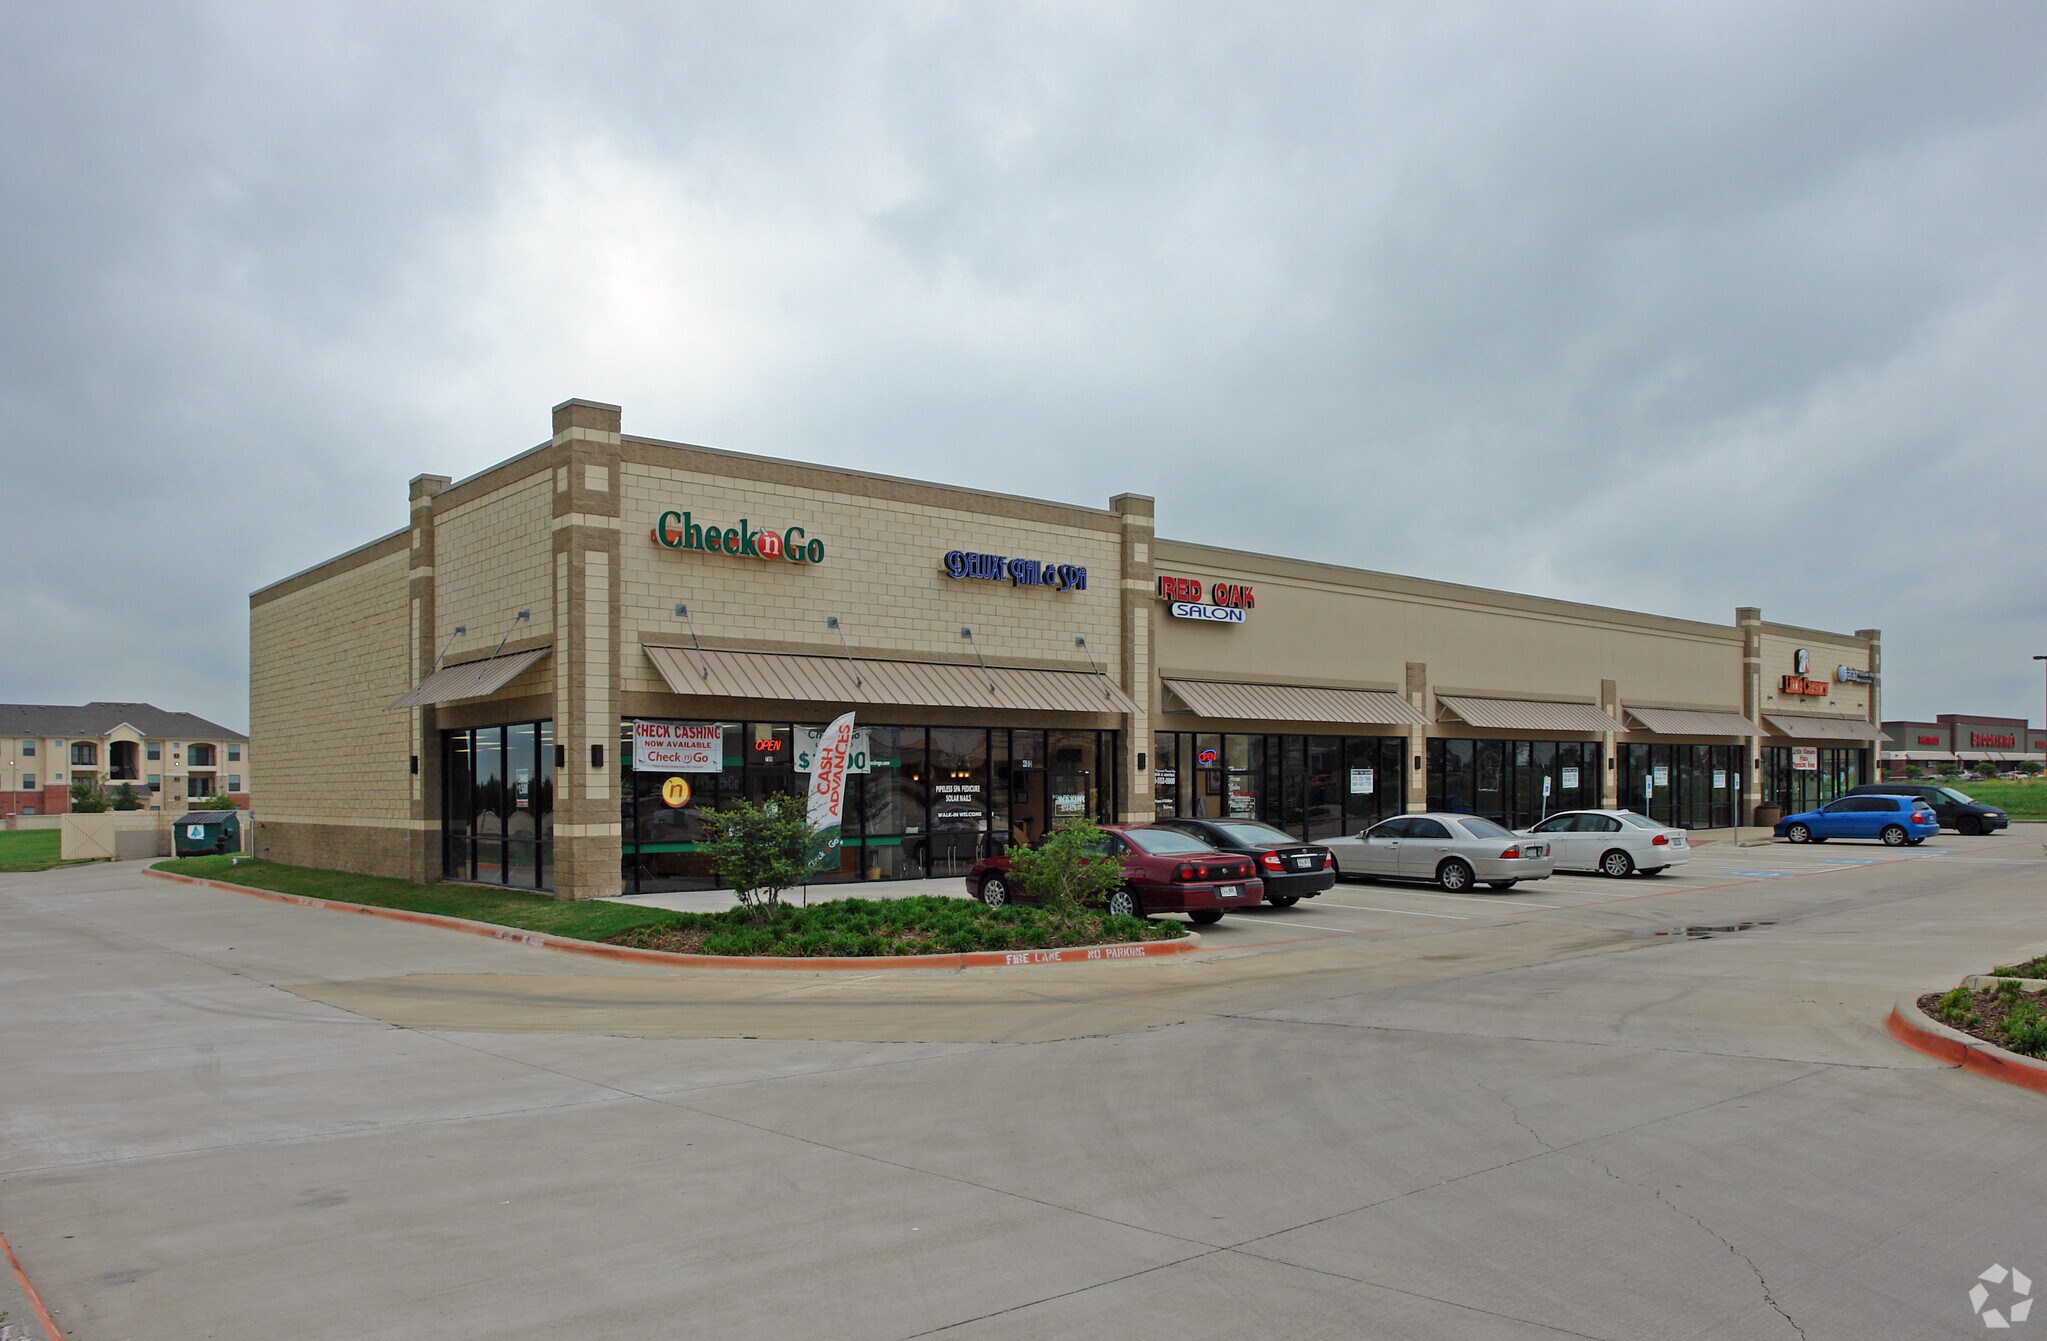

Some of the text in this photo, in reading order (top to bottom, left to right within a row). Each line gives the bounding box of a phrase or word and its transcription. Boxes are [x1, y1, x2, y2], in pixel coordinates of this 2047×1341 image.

[657, 511, 759, 557] Check
[784, 526, 825, 564] Go
[944, 550, 1087, 591] DELUXE NAIL & SPA
[1160, 576, 1255, 608] RED OAK
[1177, 604, 1242, 621] SALON
[636, 724, 720, 739] CHECK CASHING
[755, 739, 781, 751] OPEN
[648, 751, 681, 762] Check
[693, 752, 708, 763] Go
[1198, 752, 1216, 761] OPEN
[817, 747, 833, 795] CASH
[829, 724, 850, 816] ADVANCES
[961, 784, 980, 793] PEDICURE
[1006, 946, 1145, 965] FIRE LANE NO PARKING
